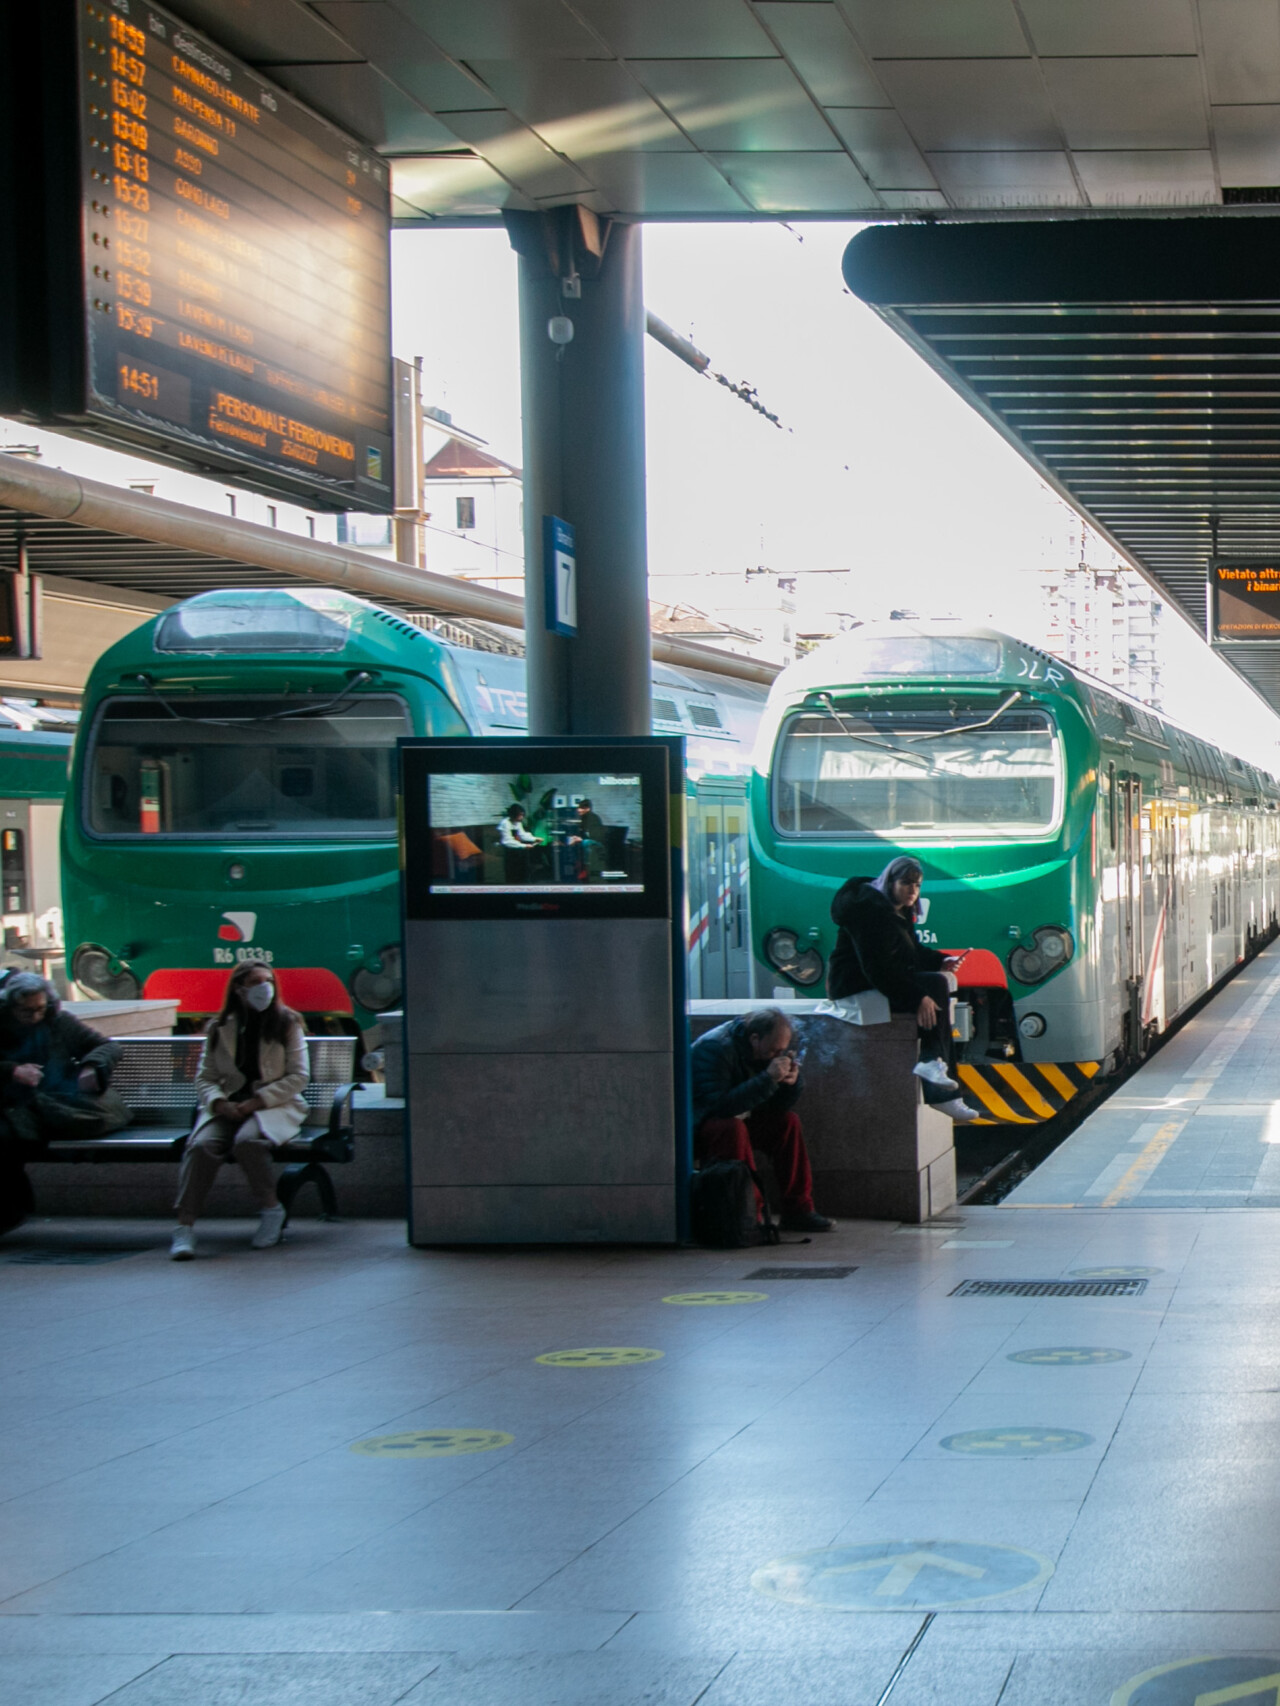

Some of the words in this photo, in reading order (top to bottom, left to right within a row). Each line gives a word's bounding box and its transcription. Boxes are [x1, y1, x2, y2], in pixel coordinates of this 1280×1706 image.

[173, 32, 231, 81] destinazione
[110, 46, 146, 87] 14:57
[172, 86, 223, 130] MALPENSA
[112, 78, 147, 120] 15:02
[113, 110, 148, 151] 15:09
[174, 148, 203, 175] ASSO
[113, 143, 149, 182] 15:13
[114, 175, 150, 213] 15:23
[119, 365, 159, 401] 14:51
[216, 392, 288, 437] PERSONALE
[562, 562, 572, 615] 7
[1217, 568, 1257, 580] Vietato
[1246, 580, 1252, 592] i
[599, 776, 640, 786] billboard
[212, 947, 235, 964] R6
